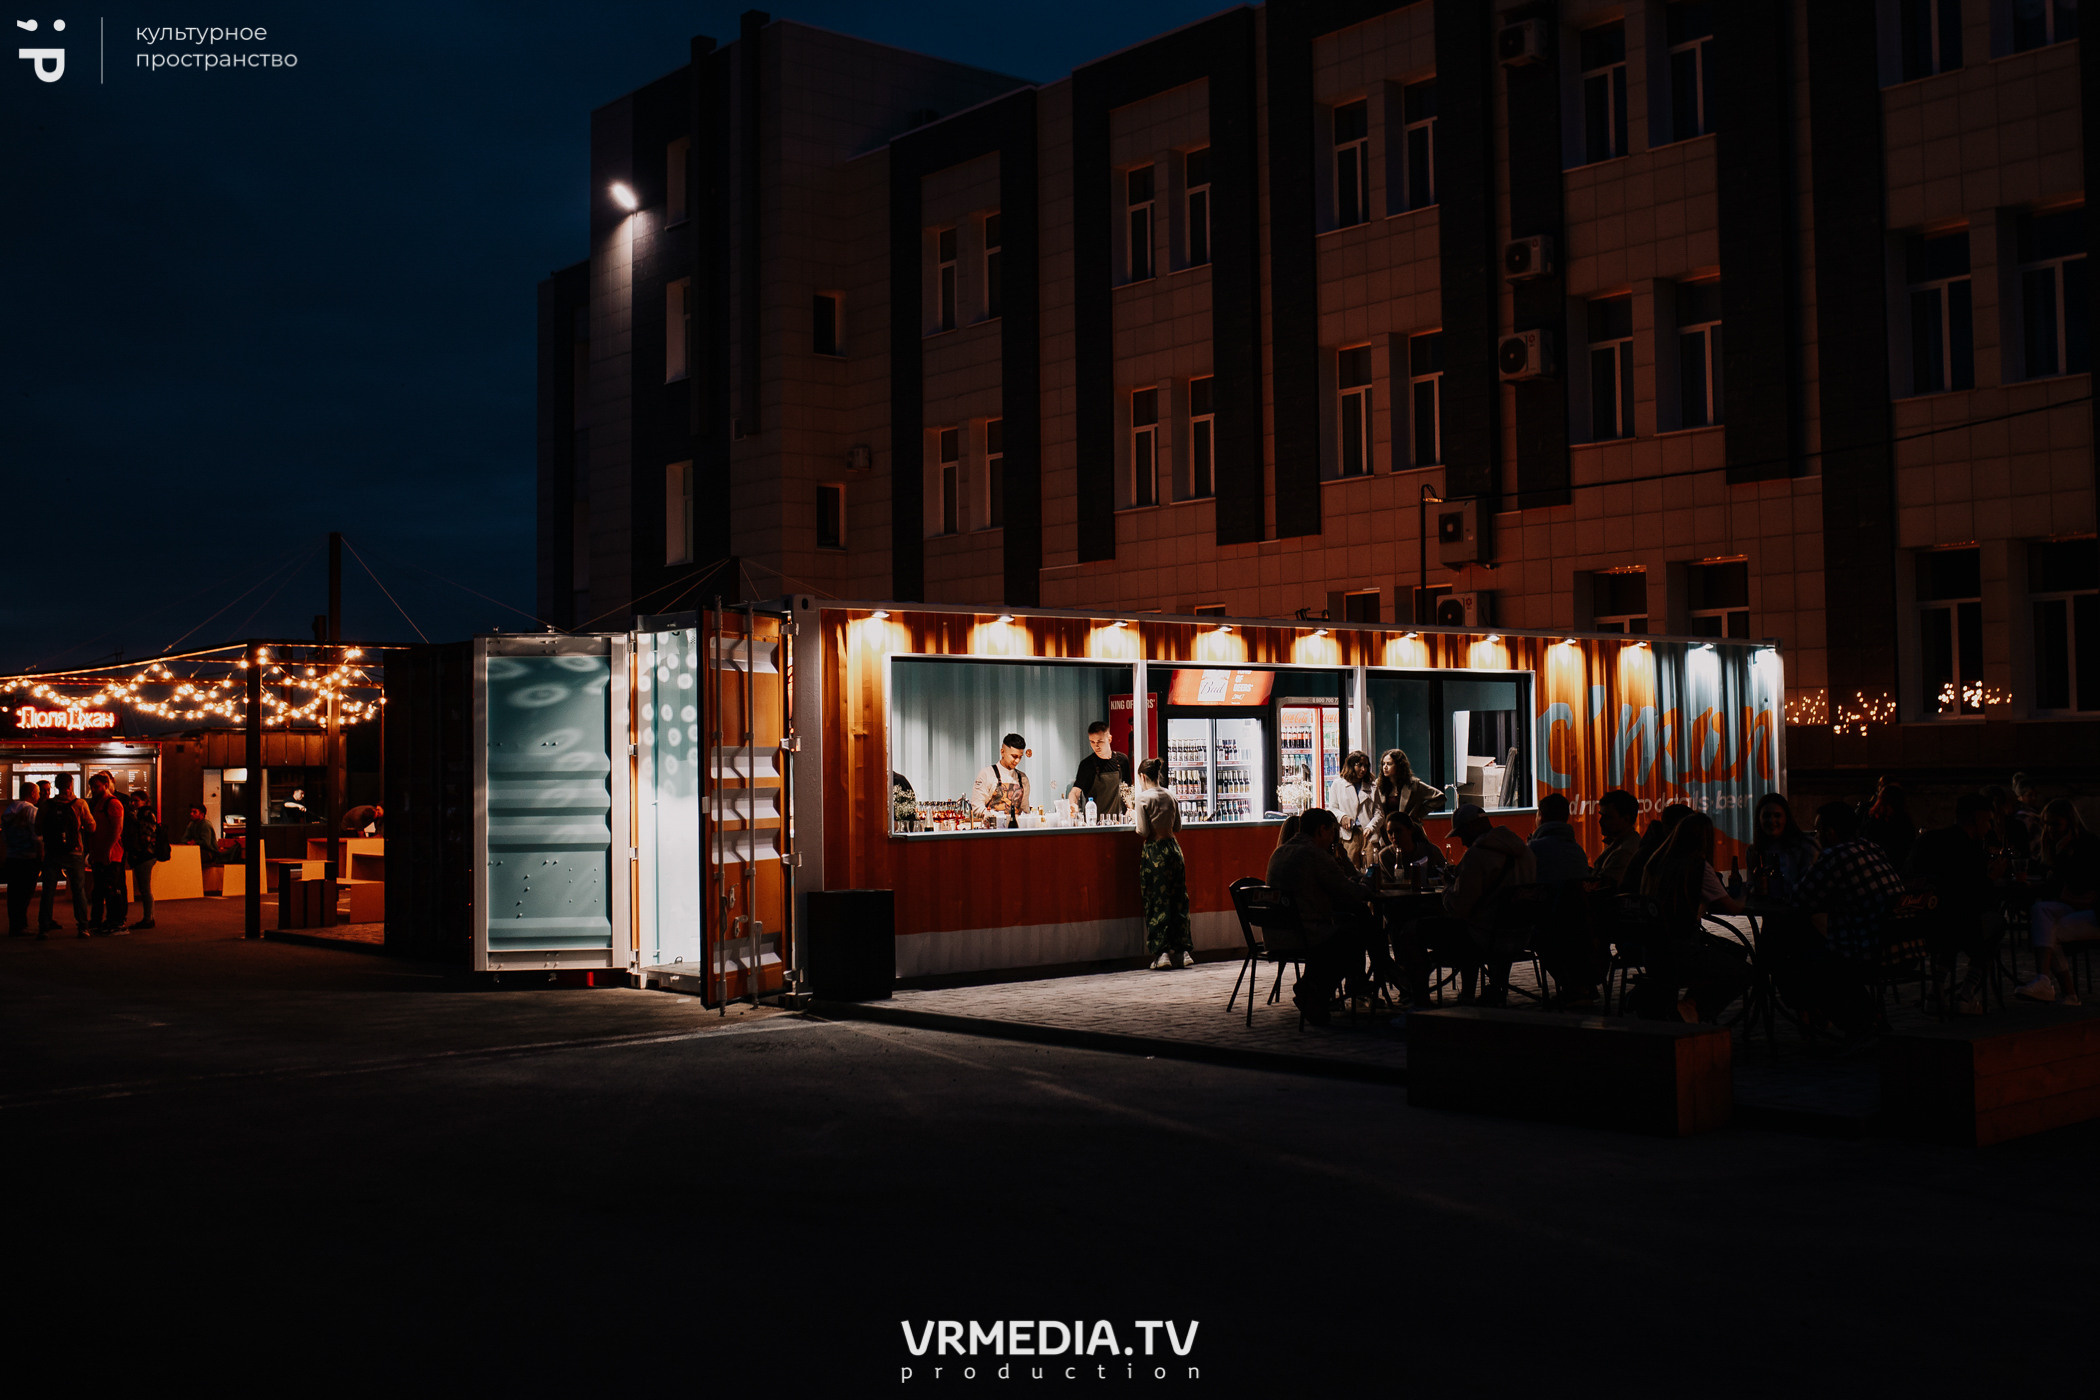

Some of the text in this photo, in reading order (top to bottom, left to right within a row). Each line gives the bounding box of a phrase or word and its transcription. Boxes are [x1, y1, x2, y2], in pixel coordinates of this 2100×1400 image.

[1110, 700, 1125, 710] KING
[1568, 792, 1597, 814] drin
[1716, 790, 1753, 811] beer
